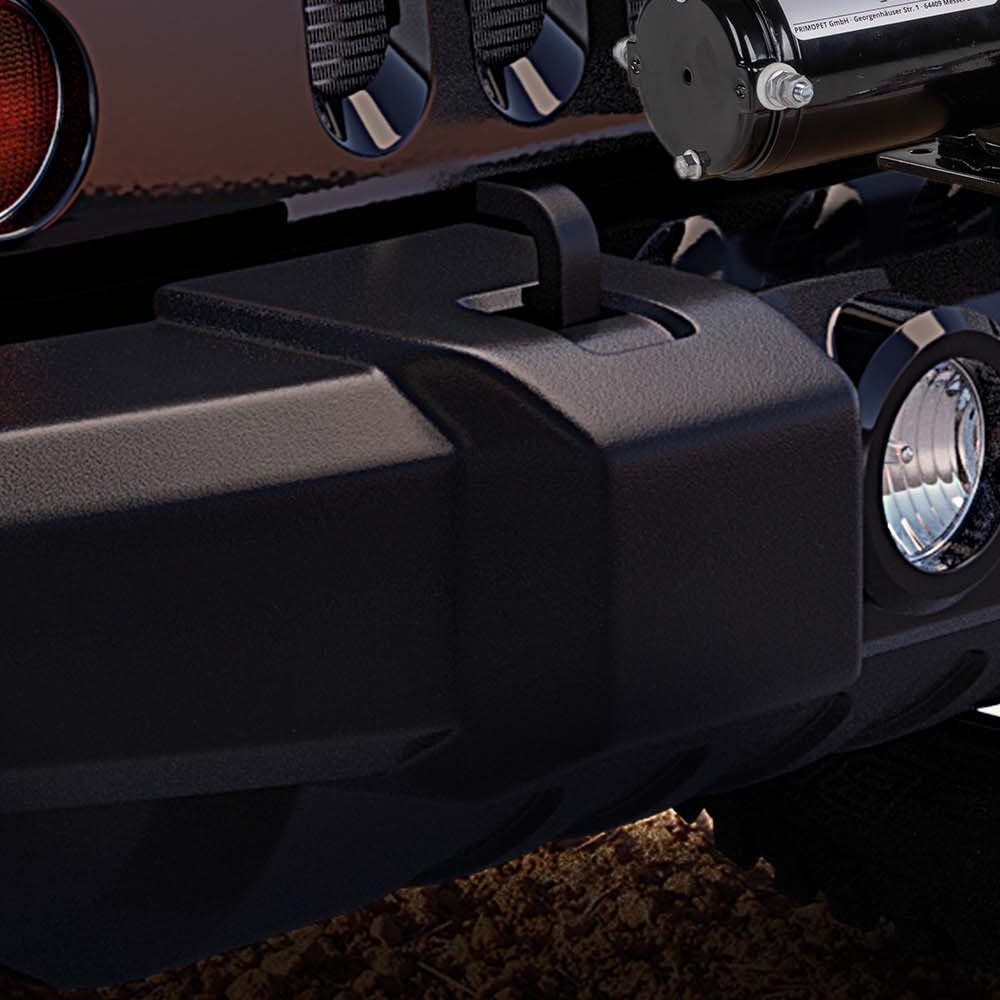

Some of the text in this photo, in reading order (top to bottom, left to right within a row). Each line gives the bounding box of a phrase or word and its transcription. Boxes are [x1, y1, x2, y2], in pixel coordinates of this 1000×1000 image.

[794, 22, 828, 34] PRIMOPET
[829, 17, 850, 27] GmbH
[853, 8, 902, 23] Georgenhäuser
[904, 5, 915, 14] Str.
[924, 0, 943, 9] 64409
